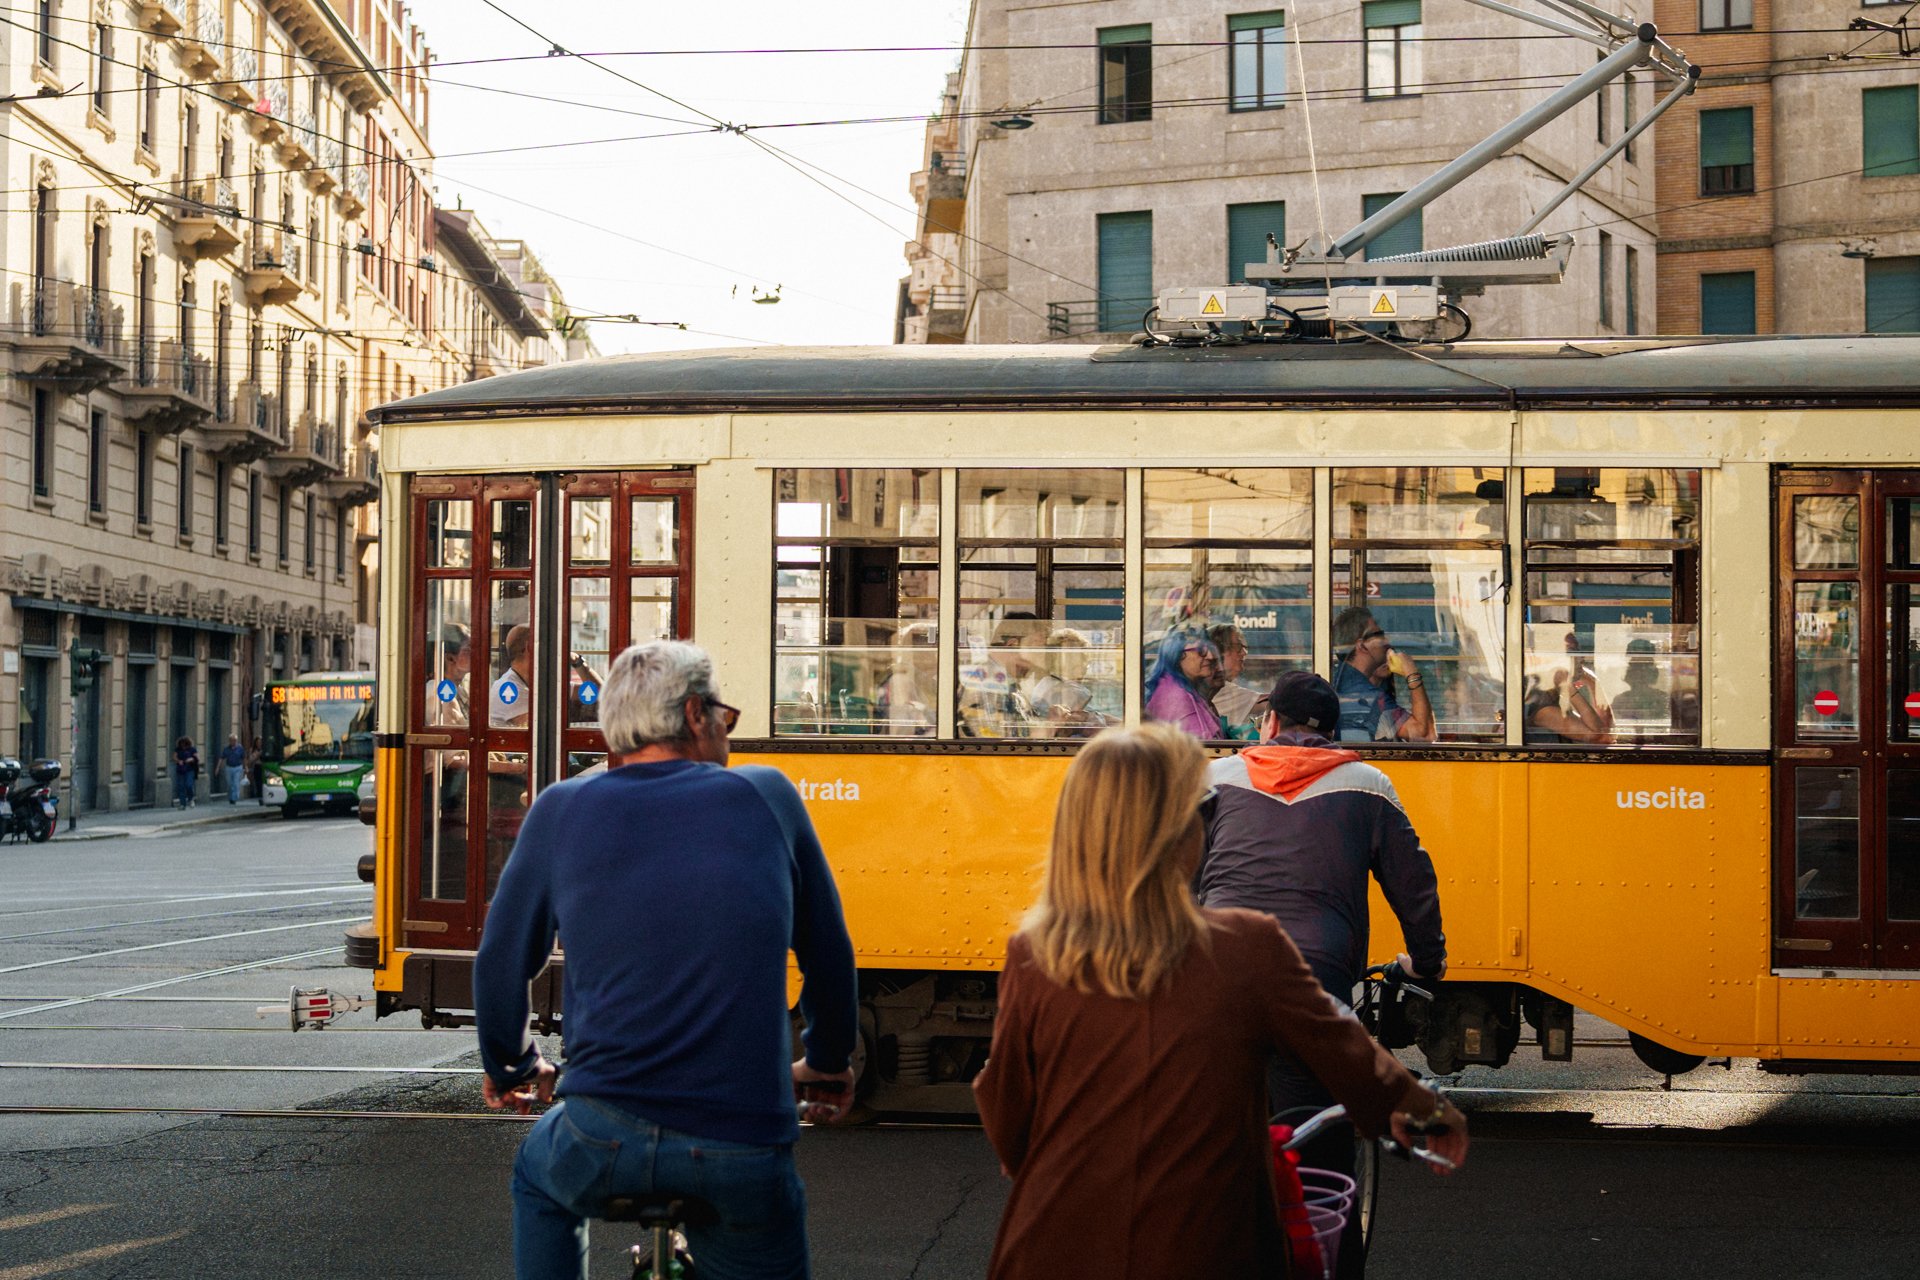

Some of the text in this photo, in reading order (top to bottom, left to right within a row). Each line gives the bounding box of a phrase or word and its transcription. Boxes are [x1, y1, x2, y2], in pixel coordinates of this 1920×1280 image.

[1233, 611, 1277, 628] tonali
[272, 687, 286, 703] 58
[795, 777, 860, 801] trata
[1616, 786, 1706, 809] uscita
